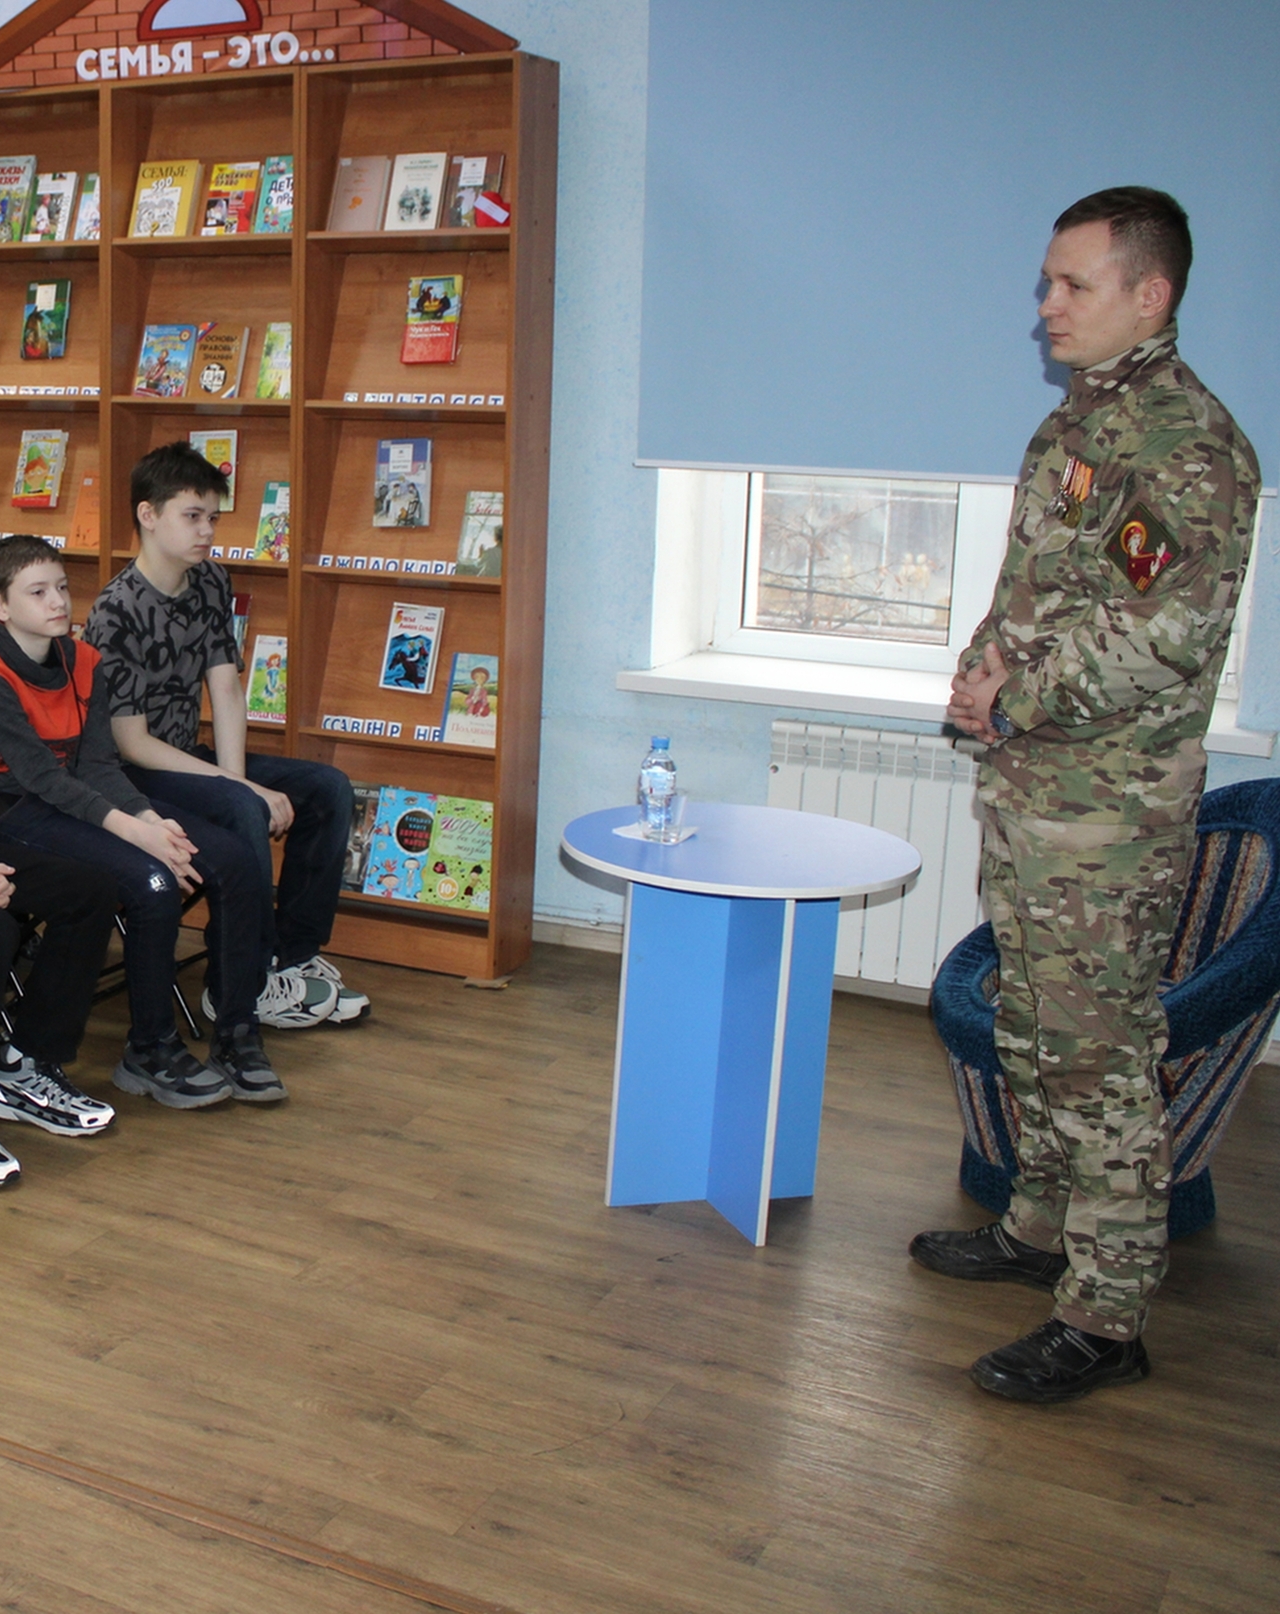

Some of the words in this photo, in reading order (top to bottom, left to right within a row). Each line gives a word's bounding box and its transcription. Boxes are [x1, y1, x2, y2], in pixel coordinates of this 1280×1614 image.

[76, 41, 193, 81] СЕМЬЯ
[227, 31, 335, 69] ЭТО...
[205, 334, 238, 342] ОСНОВЫ
